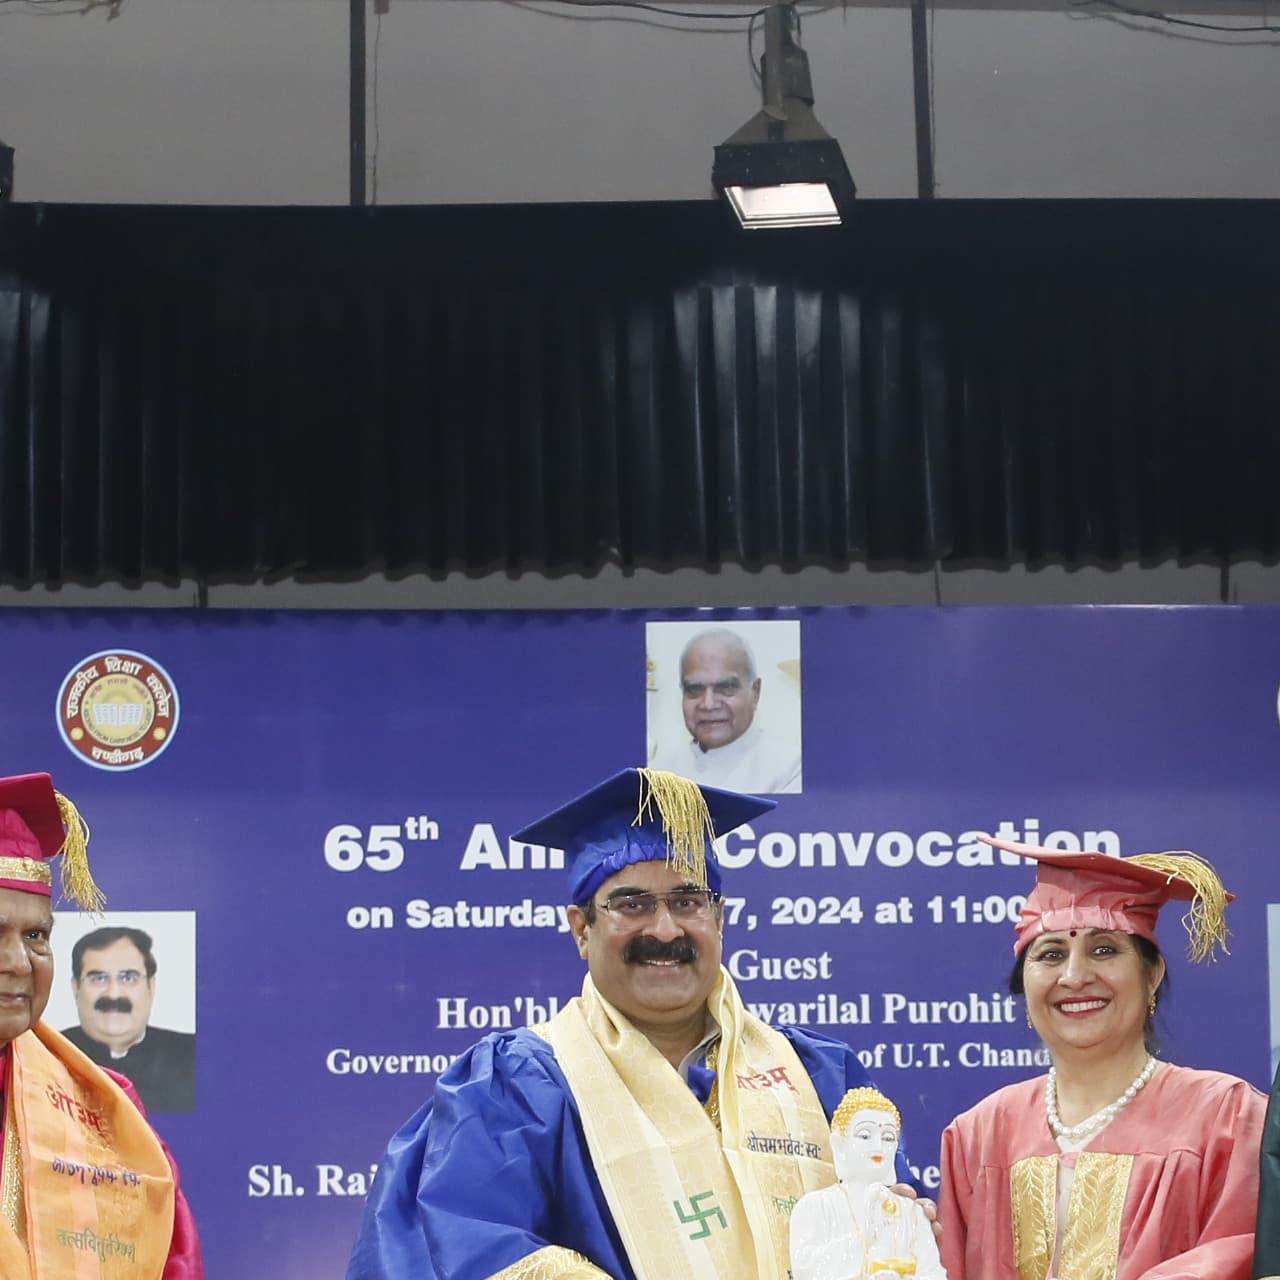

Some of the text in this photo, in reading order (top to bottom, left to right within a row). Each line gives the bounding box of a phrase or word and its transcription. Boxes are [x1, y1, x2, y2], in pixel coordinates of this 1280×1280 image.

[346, 906, 394, 929] on
[771, 897, 863, 925] 2024
[874, 897, 913, 924] at
[728, 949, 832, 981] Guest
[882, 993, 1016, 1024] Purohit
[857, 1043, 887, 1069] of
[892, 1043, 950, 1069] U.T.
[248, 1164, 305, 1197] Sh.
